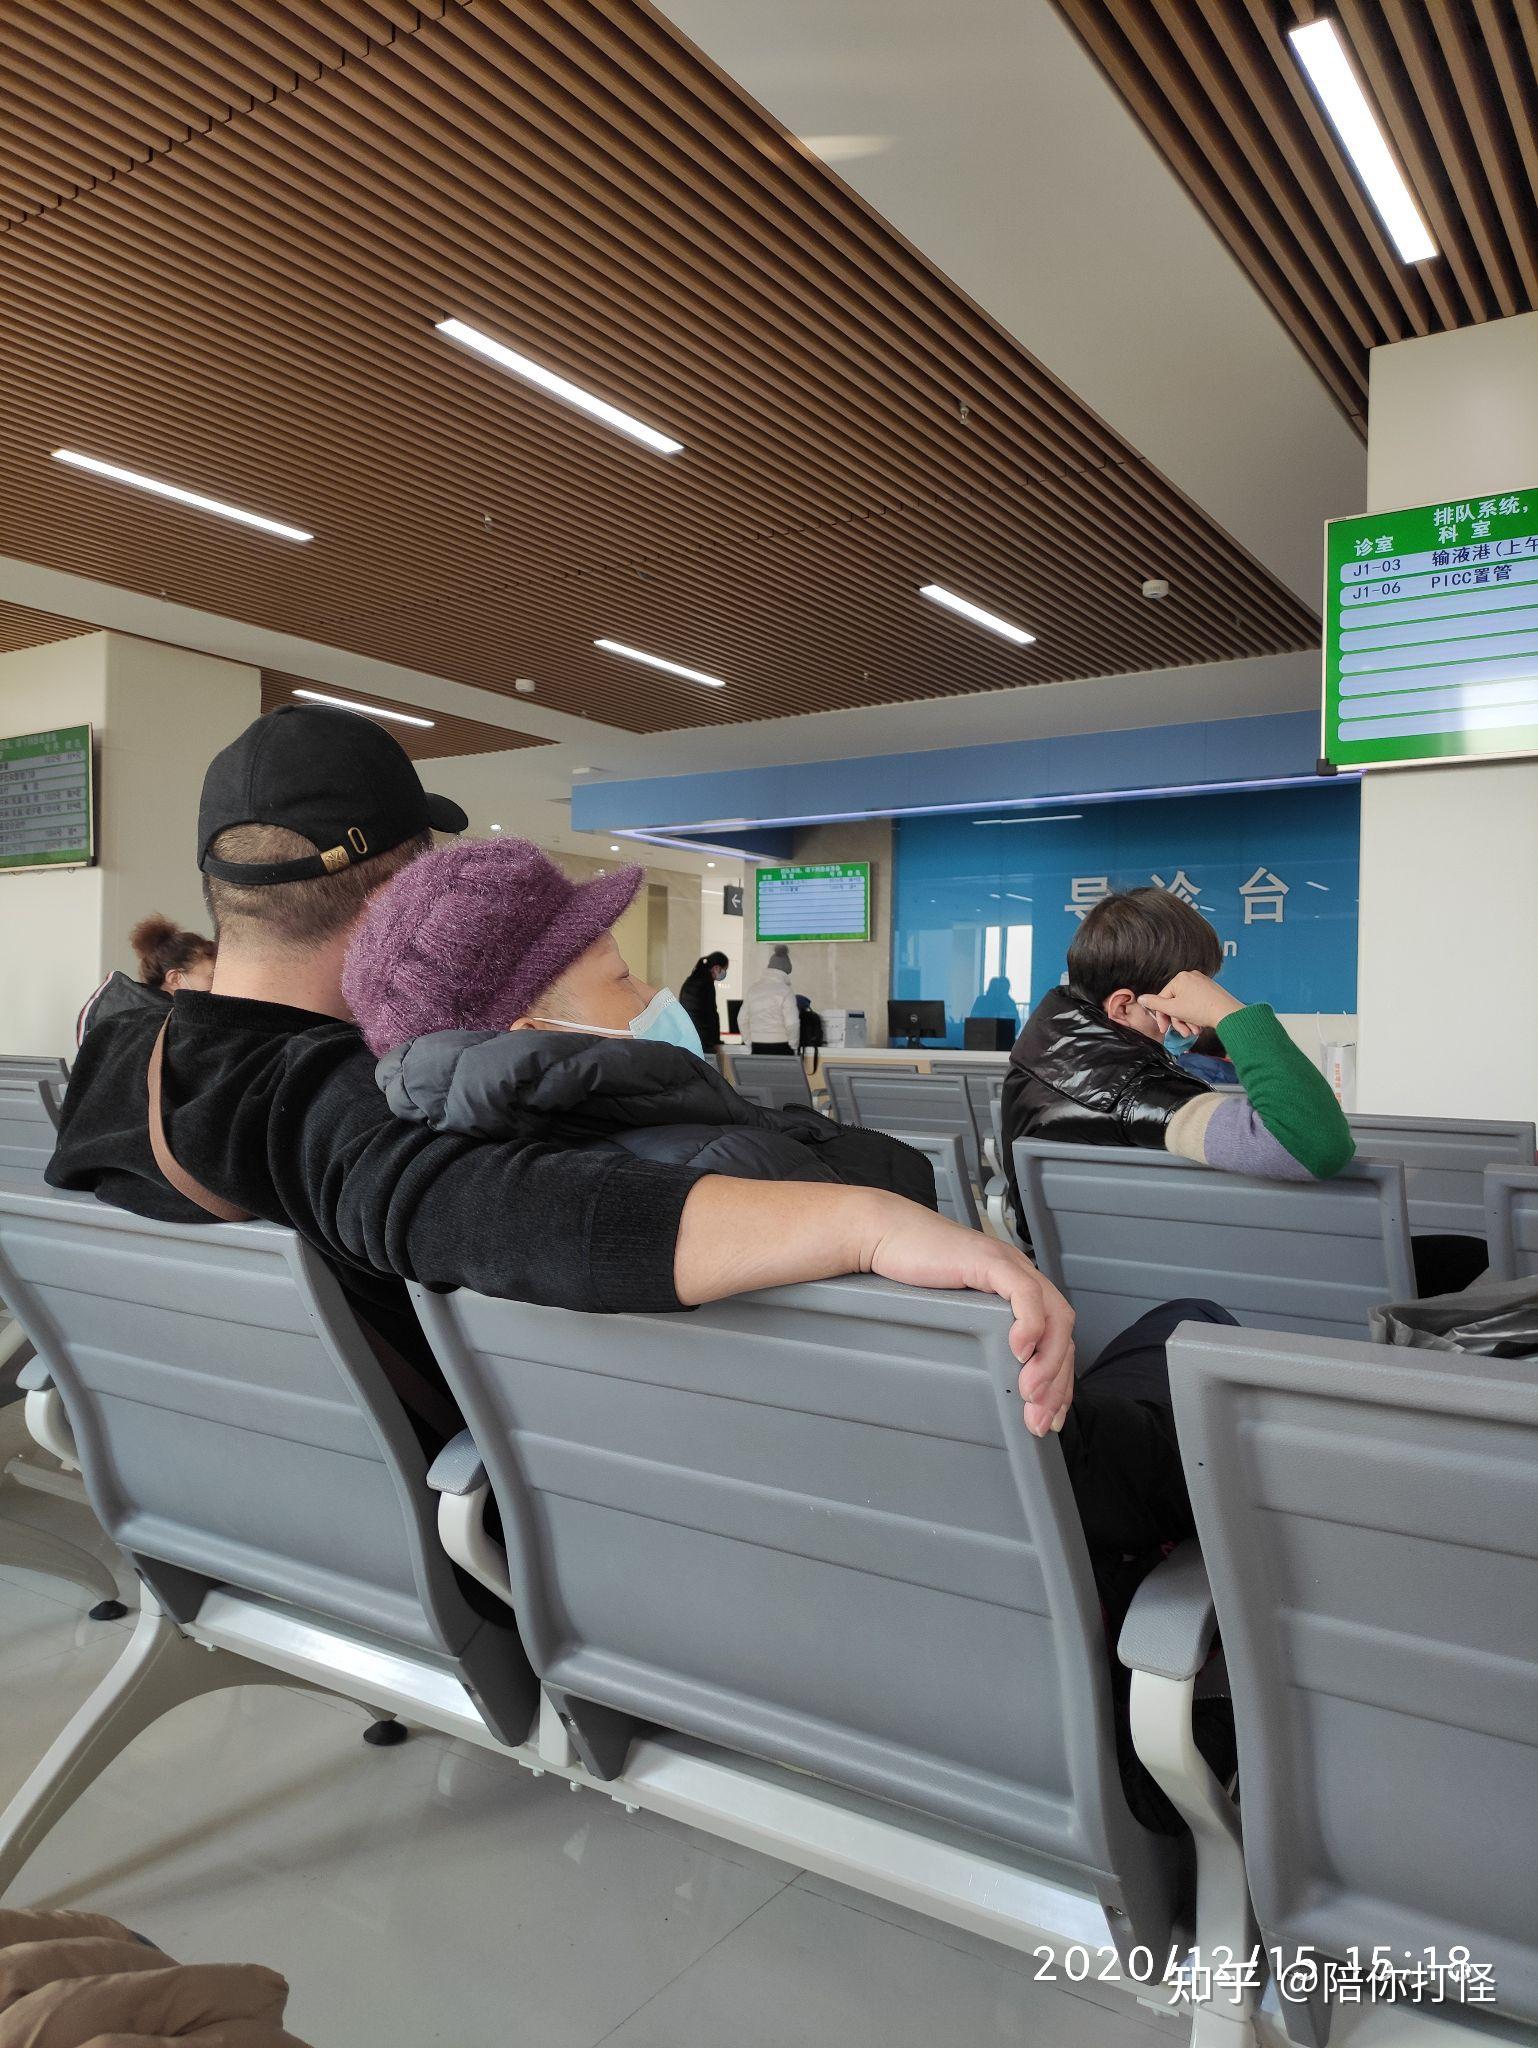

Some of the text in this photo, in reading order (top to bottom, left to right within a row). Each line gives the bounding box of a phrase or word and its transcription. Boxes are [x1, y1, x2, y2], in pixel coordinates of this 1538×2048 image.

[1354, 536, 1394, 557] 诊室
[1353, 558, 1401, 577] J1-03
[1353, 564, 1513, 600] J1-06 PICC置管
